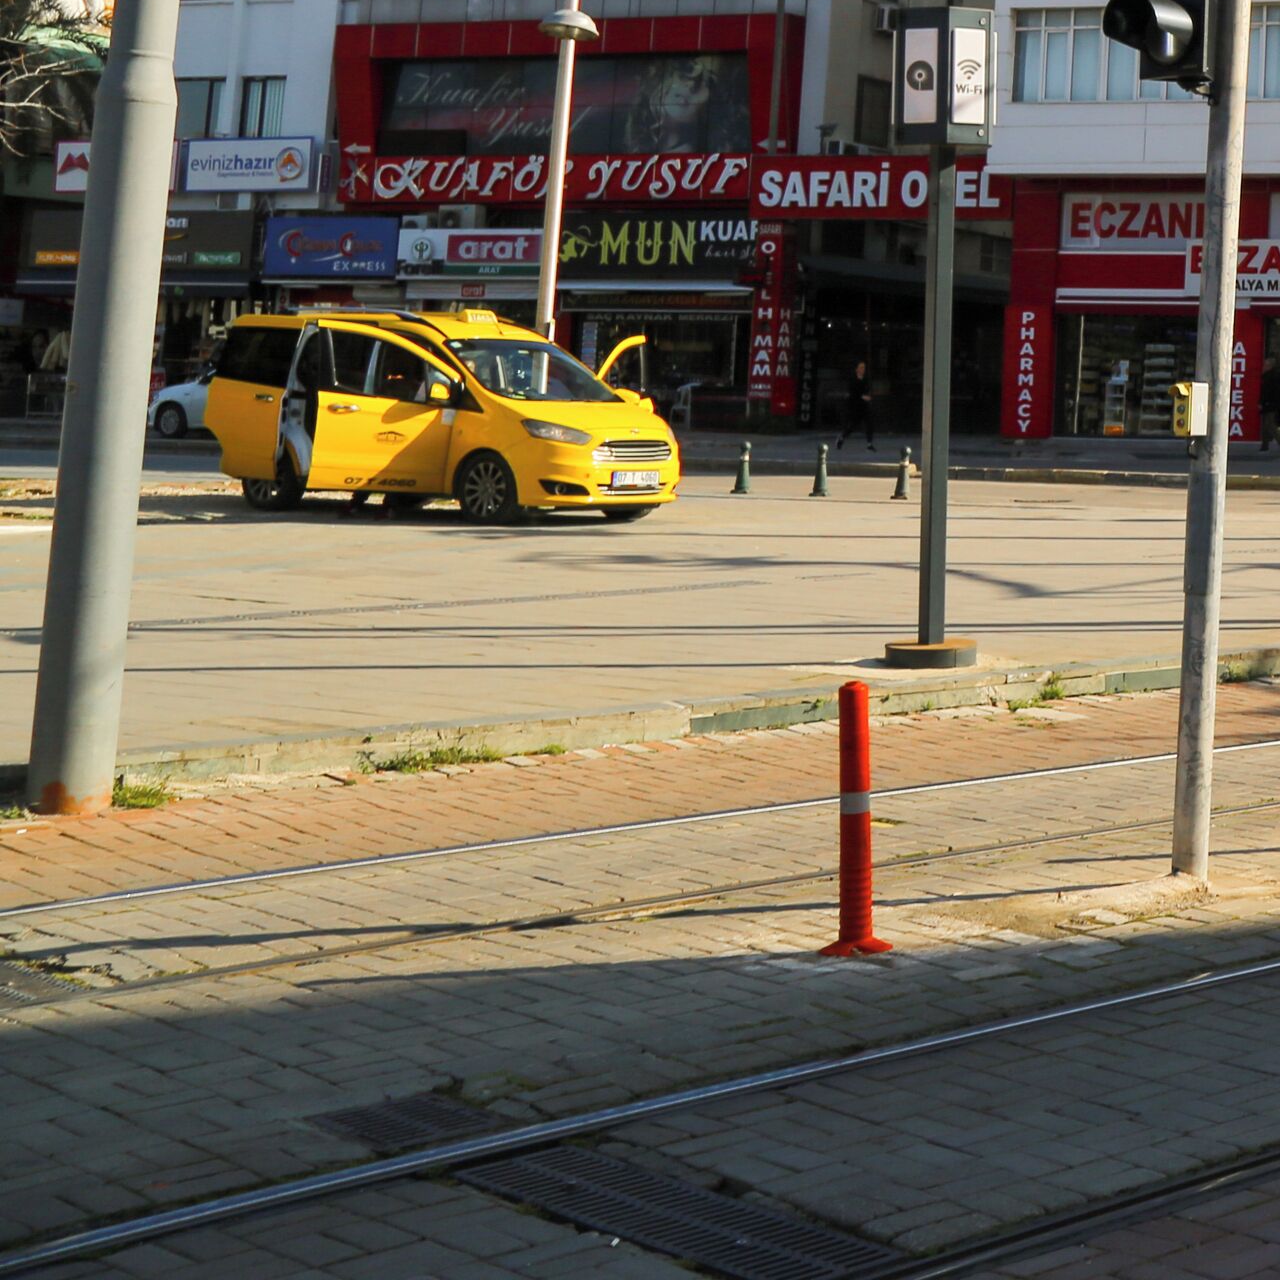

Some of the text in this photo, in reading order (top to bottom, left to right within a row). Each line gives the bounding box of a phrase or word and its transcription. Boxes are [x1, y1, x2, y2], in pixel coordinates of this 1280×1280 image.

[398, 72, 527, 111] Kuaför
[956, 84, 982, 95] Wi-Fi
[190, 153, 275, 171] evinizhazır
[586, 153, 748, 200] YUSUF
[758, 161, 1000, 208] SAFARİ OEL
[458, 236, 529, 261] arat
[600, 221, 697, 265] MUN
[1235, 279, 1264, 292] ALYA
[752, 307, 773, 376] HMAM
[1017, 312, 1036, 434] PHARMACY
